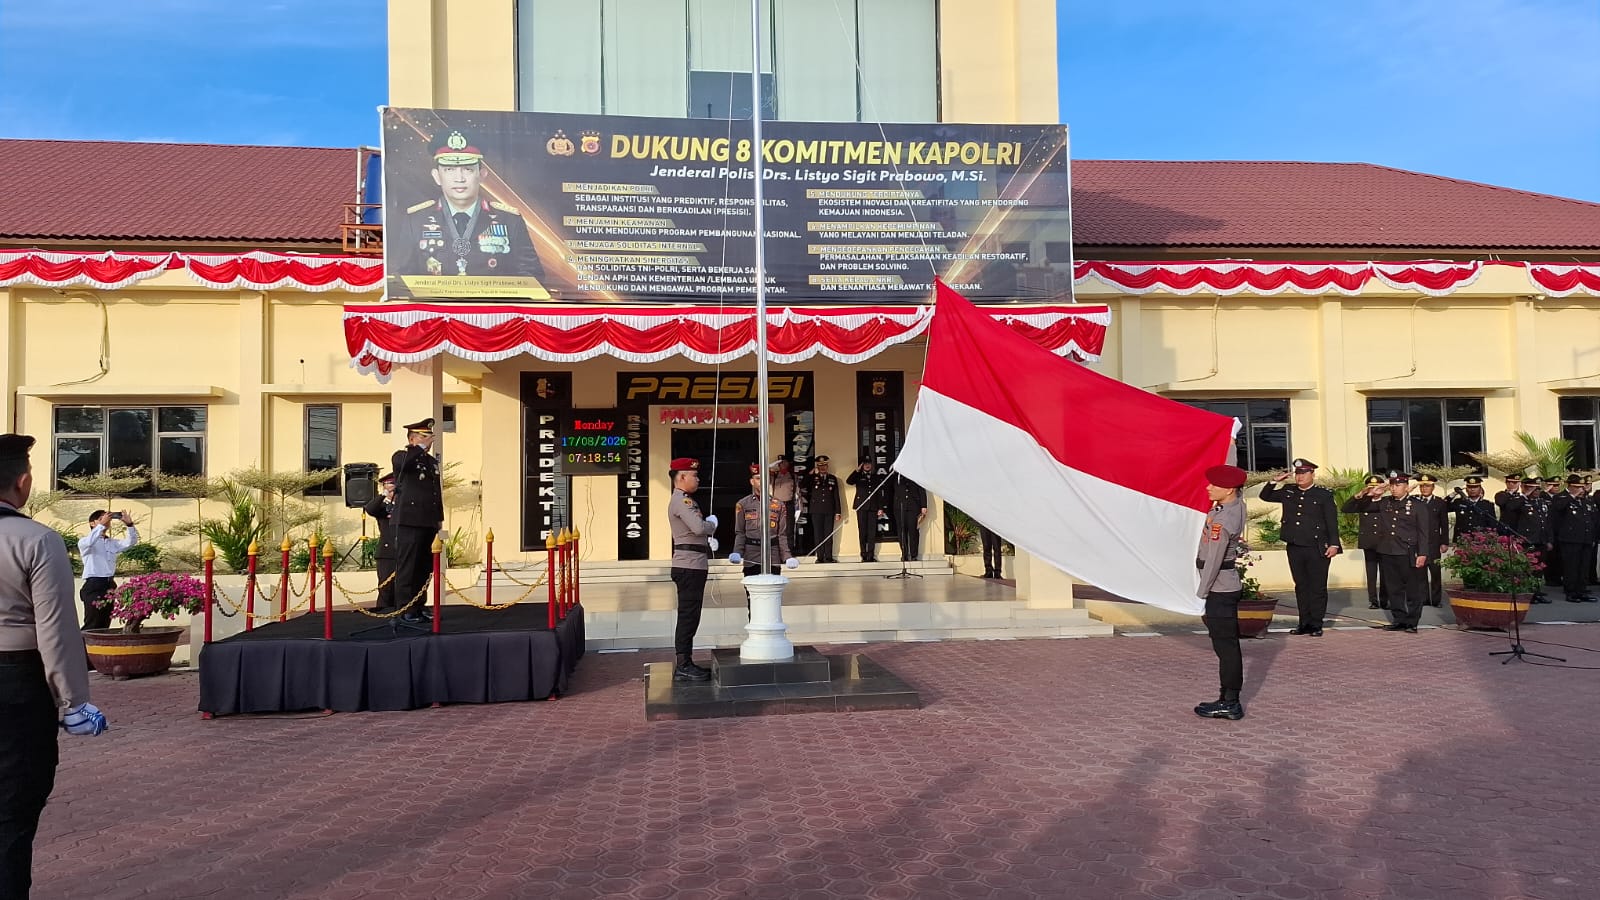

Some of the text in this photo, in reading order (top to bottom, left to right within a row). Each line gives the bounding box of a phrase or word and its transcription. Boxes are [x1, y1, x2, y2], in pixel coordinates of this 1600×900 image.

[610, 134, 1022, 166] DUKUNG 8 KOMITMEN KAPOLRI
[650, 165, 987, 184] Jenderal Polis Drs. Listyo Sigit Prabowo, M.Si.
[575, 194, 789, 208] SEBAGAI INSTITUSI YANG PREDIKTIF, RESPONSILITAS,
[576, 204, 636, 213] TRANSPARANSI
[638, 206, 655, 214] DAN
[656, 206, 712, 215] BERKEADILAN
[605, 227, 657, 236] MENDUKUNG
[658, 228, 697, 236] PROGRAM
[820, 254, 884, 262] PERMASALAHAN,
[982, 253, 1029, 261] RESTORATIF,
[596, 264, 636, 272] SOLIDITAS
[638, 265, 680, 273] TNI-POLRI,
[708, 266, 744, 274] BEKERJA
[612, 274, 629, 282] APH
[649, 275, 706, 283] KEMENTERIAN
[630, 284, 647, 292] DAN
[649, 285, 694, 293] MENGAWAL
[696, 285, 734, 293] PROGRAM
[626, 376, 804, 400] PRESISI
[574, 420, 615, 431] Monday
[561, 436, 627, 448] 17/08/2026
[568, 453, 622, 464] 07:18:54
[539, 415, 556, 540] PREDEKTIF
[626, 415, 642, 539] RESPONSIBILITAS
